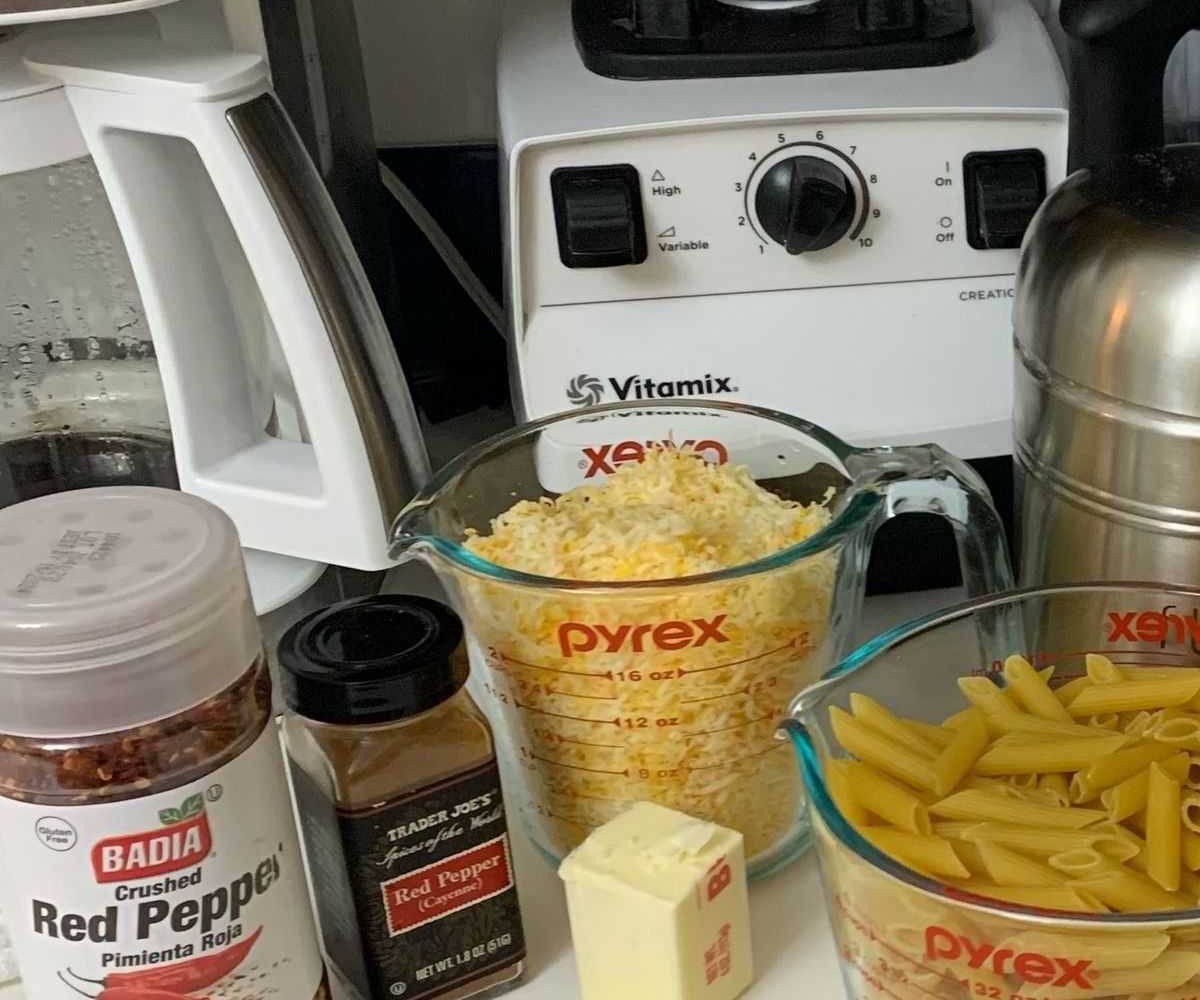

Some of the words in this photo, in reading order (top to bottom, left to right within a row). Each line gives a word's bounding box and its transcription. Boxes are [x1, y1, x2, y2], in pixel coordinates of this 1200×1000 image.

[778, 134, 785, 143] 5
[816, 131, 824, 140] 6
[850, 146, 857, 155] 7
[748, 152, 757, 162] 4
[870, 175, 878, 184] 8
[935, 177, 952, 187] On
[652, 186, 681, 197] High
[735, 183, 742, 192] 3
[873, 209, 881, 218] 9
[738, 217, 745, 226] 2
[859, 238, 872, 247] 10
[935, 233, 954, 242] Off
[658, 240, 709, 252] Variable
[608, 374, 732, 400] Vitamix
[558, 614, 730, 657] pyrex
[617, 671, 642, 681] 16
[650, 670, 675, 680] oz
[625, 717, 648, 728] 12
[656, 717, 679, 727] oz
[639, 769, 650, 778] 8
[387, 810, 449, 841] TRADER
[451, 793, 492, 817] JOE'S
[39, 826, 72, 836] Gluten
[46, 835, 68, 843] Free
[102, 825, 202, 873] BADIA
[116, 867, 202, 901] Crushed
[394, 879, 432, 906] Red
[437, 855, 500, 888] Pepper
[418, 877, 483, 912] (Cayenne)
[32, 900, 118, 943] Red
[102, 942, 194, 967] Pimienta
[202, 923, 242, 951] Roja
[924, 925, 1094, 989] pyrex
